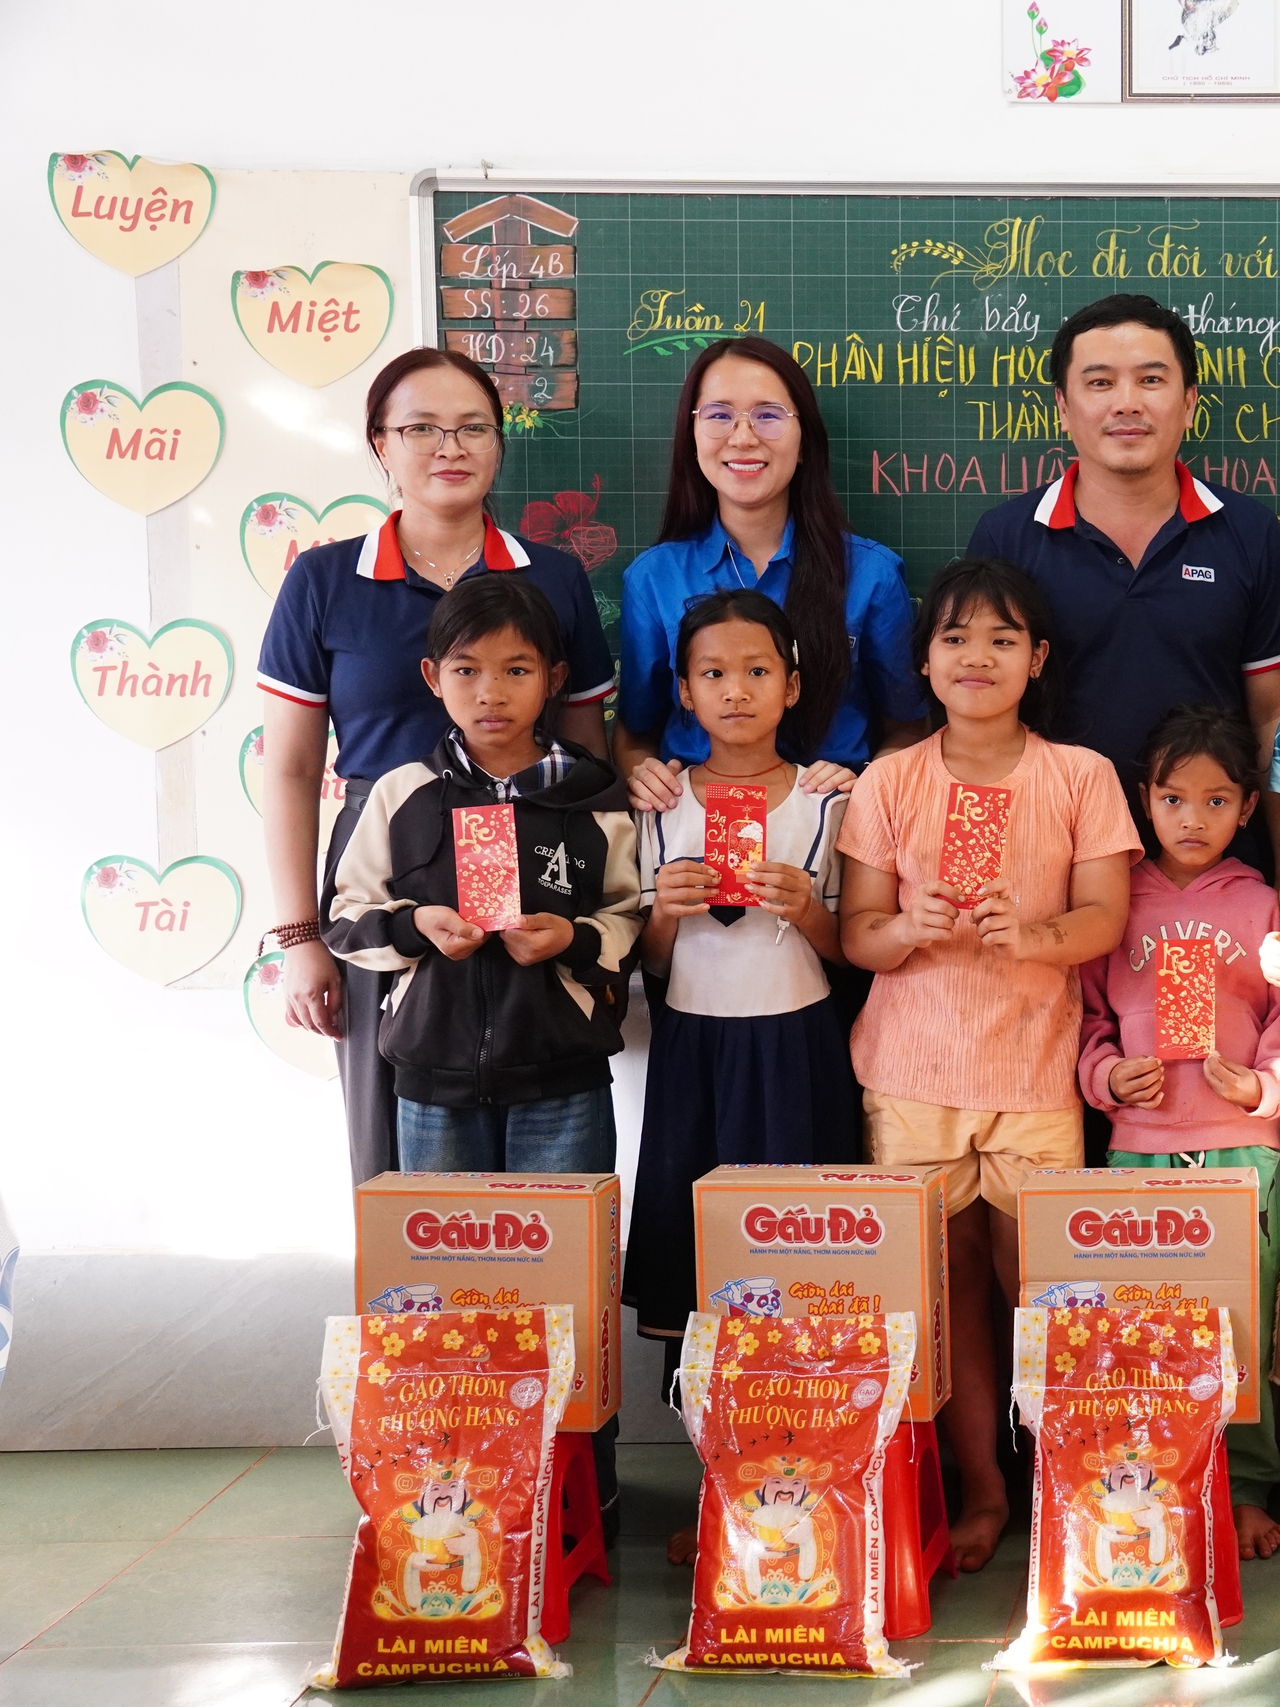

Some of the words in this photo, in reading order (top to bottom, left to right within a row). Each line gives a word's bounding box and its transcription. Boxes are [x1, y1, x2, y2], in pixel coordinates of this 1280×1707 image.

[71, 185, 193, 232] Luyện
[459, 245, 522, 288] Lớp
[529, 252, 564, 278] 4B
[1219, 236, 1279, 279] với
[513, 293, 550, 318] 26
[627, 289, 724, 340] Tuần
[734, 300, 765, 333] 21
[892, 293, 961, 332] Thứ
[267, 298, 360, 342] Miệt
[793, 332, 884, 388] PHÂN
[897, 333, 975, 398] HIỆU
[105, 427, 179, 461] Mãi
[872, 450, 987, 497] KHOA
[1184, 567, 1212, 580] APAG
[92, 661, 212, 698] Thành
[135, 898, 191, 932] Tài
[493, 1287, 520, 1304] dai
[788, 1281, 826, 1299] Giòn
[829, 1280, 854, 1297] dai
[1113, 1284, 1152, 1302] Giòn
[1155, 1283, 1182, 1300] dai
[808, 1297, 844, 1315] nhai
[399, 1377, 443, 1406] GẠO
[449, 1374, 507, 1398] THƠM
[748, 1379, 791, 1404] GẠO
[796, 1379, 849, 1400] THƠM
[1086, 1367, 1126, 1394] GẠO
[1133, 1367, 1184, 1393] THƠM
[465, 1406, 521, 1430] HẠNG
[810, 1409, 860, 1431] HẠNG
[1151, 1399, 1200, 1417] HẠNG
[1070, 1608, 1108, 1627] LÀI
[1116, 1607, 1176, 1627] MIÊN
[377, 1637, 421, 1654] LÀI
[425, 1636, 488, 1653] MIÊN
[720, 1626, 757, 1644] LÀI
[765, 1626, 825, 1644] MIÊN
[1051, 1634, 1194, 1651] CAMPUCHIA
[357, 1659, 509, 1677] CAMPUCHIA
[703, 1652, 847, 1666] CAMPUCHIA
